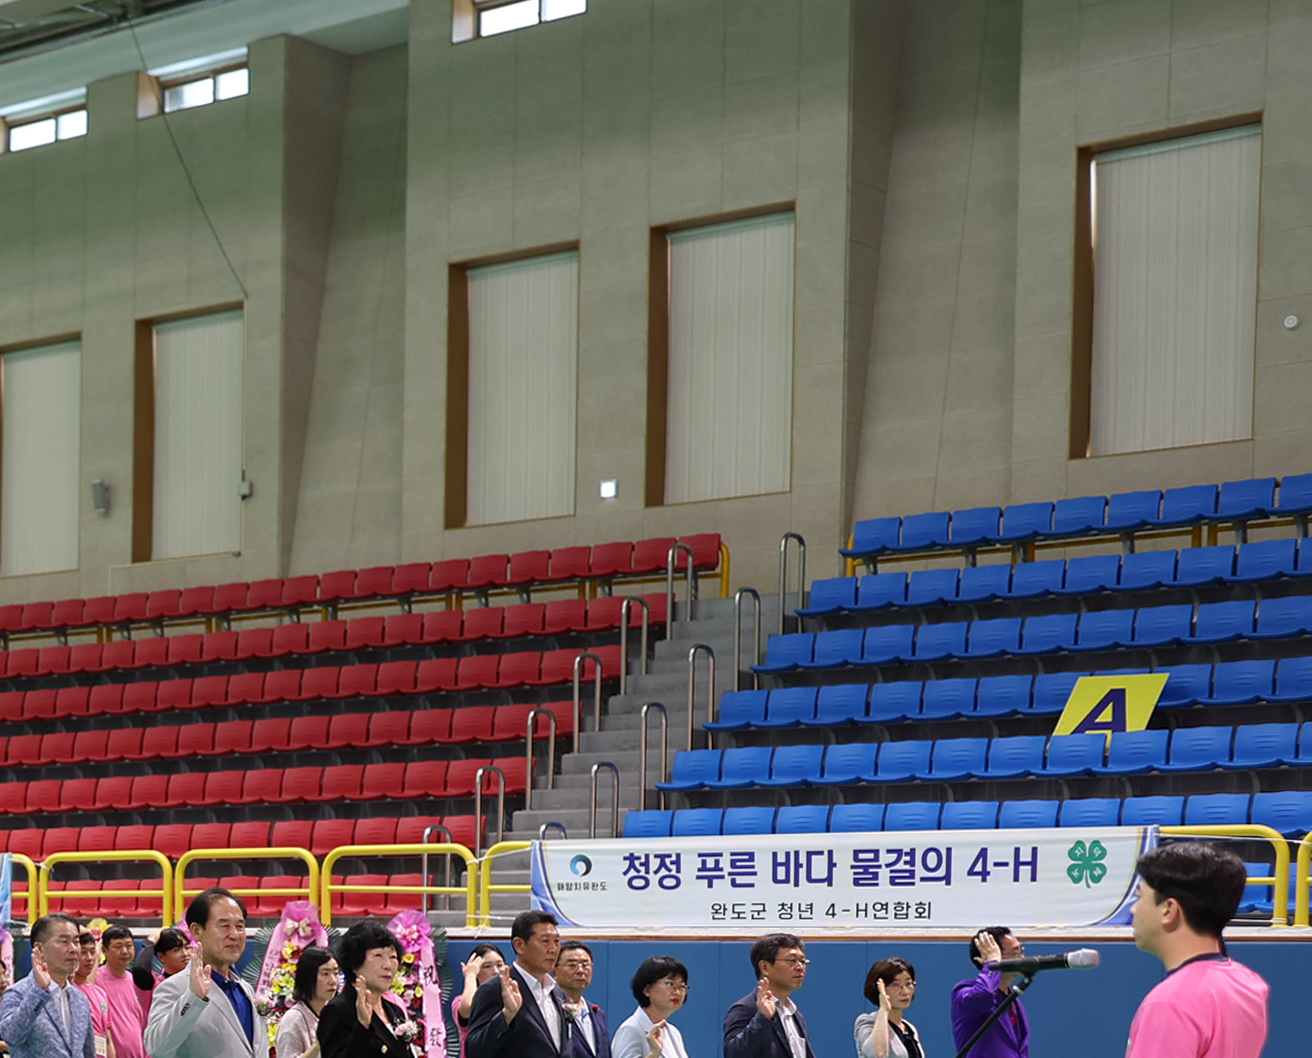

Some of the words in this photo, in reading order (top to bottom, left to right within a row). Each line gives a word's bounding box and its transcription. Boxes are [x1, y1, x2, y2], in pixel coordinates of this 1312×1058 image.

[1071, 687, 1127, 735] A
[622, 852, 682, 891] 청정
[695, 851, 758, 889] 푸른
[772, 849, 837, 888] 바다
[850, 847, 953, 888] 물결의
[967, 846, 1038, 883] 4-H
[711, 902, 767, 921] 완도군
[777, 902, 814, 920] 청년
[825, 901, 932, 920] 4-H연합회
